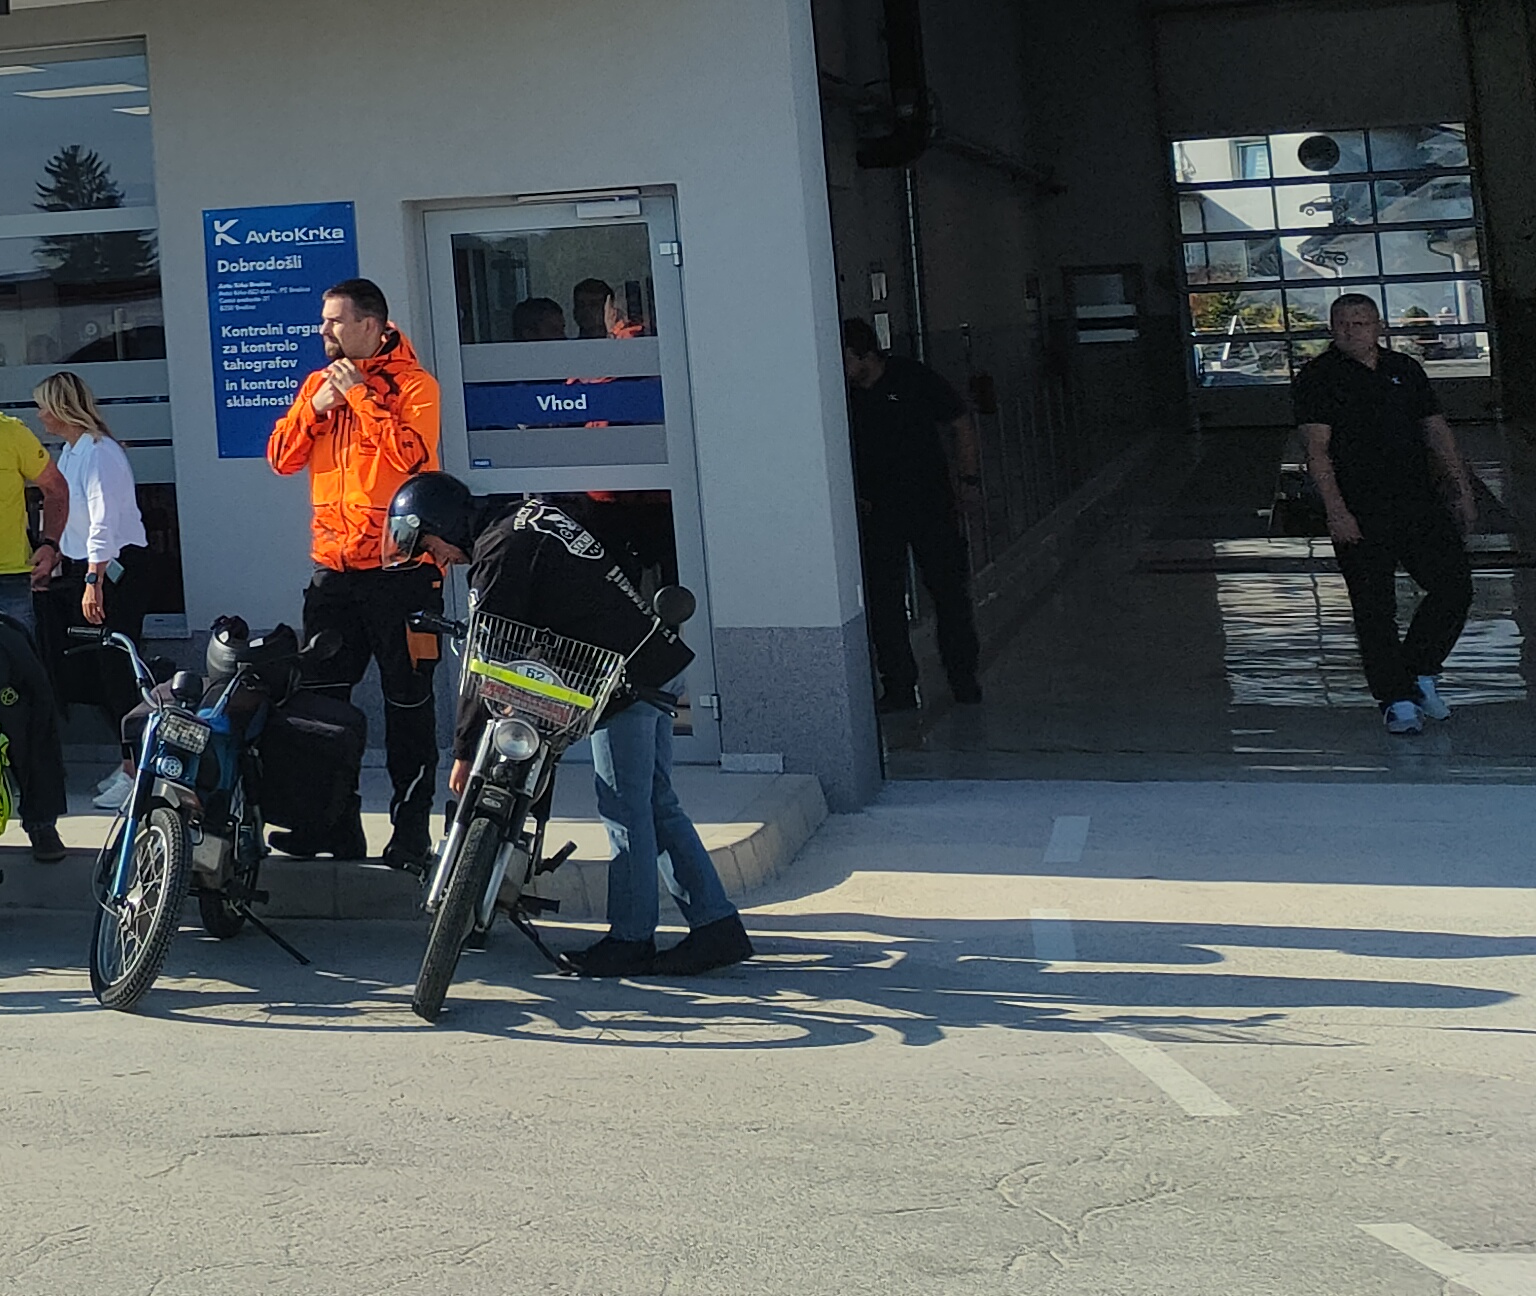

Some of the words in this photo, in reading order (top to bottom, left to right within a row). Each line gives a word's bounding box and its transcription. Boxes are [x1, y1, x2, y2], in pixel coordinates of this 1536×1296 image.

[245, 226, 345, 244] AvtoKrka
[217, 255, 303, 273] Dobrodošli
[221, 323, 284, 338] Kontrolni
[286, 324, 322, 336] orga
[222, 345, 238, 354] za
[241, 339, 299, 353] kontrolo
[223, 356, 298, 372] tahografov
[225, 379, 238, 391] in
[241, 376, 299, 390] kontrolo
[536, 393, 588, 412] Vhod
